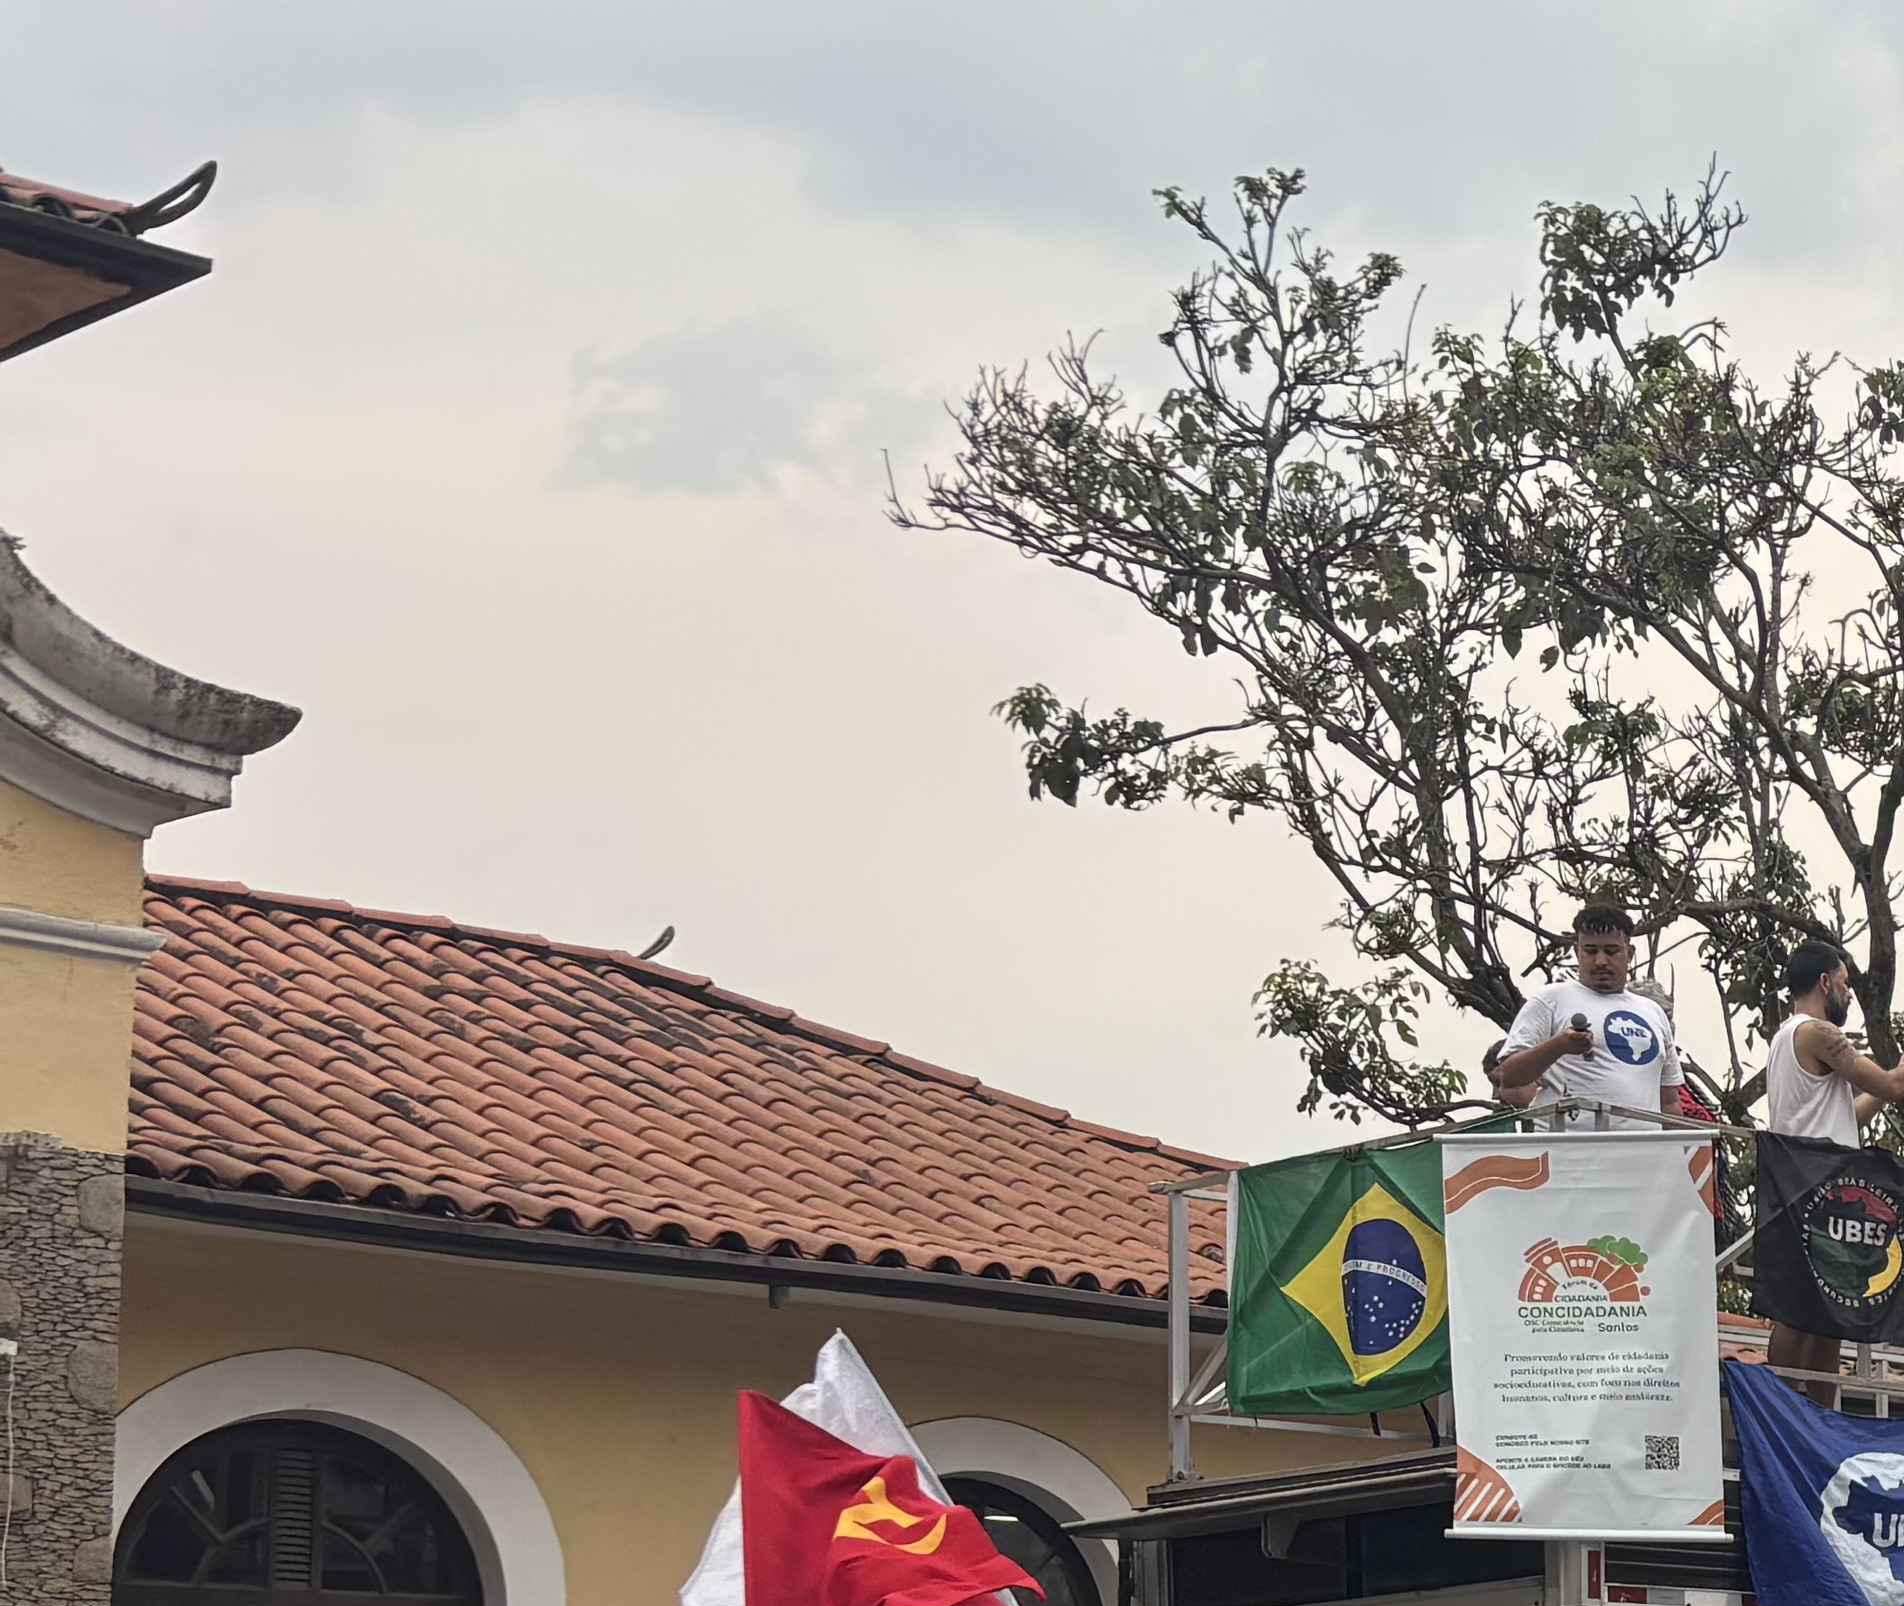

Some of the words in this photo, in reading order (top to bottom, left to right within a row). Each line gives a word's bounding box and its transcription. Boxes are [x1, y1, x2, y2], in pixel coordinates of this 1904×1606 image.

[1828, 1215, 1889, 1247] UBES
[1517, 1305, 1648, 1320] CONCIDADANIA
[1597, 1321, 1640, 1334] Santos
